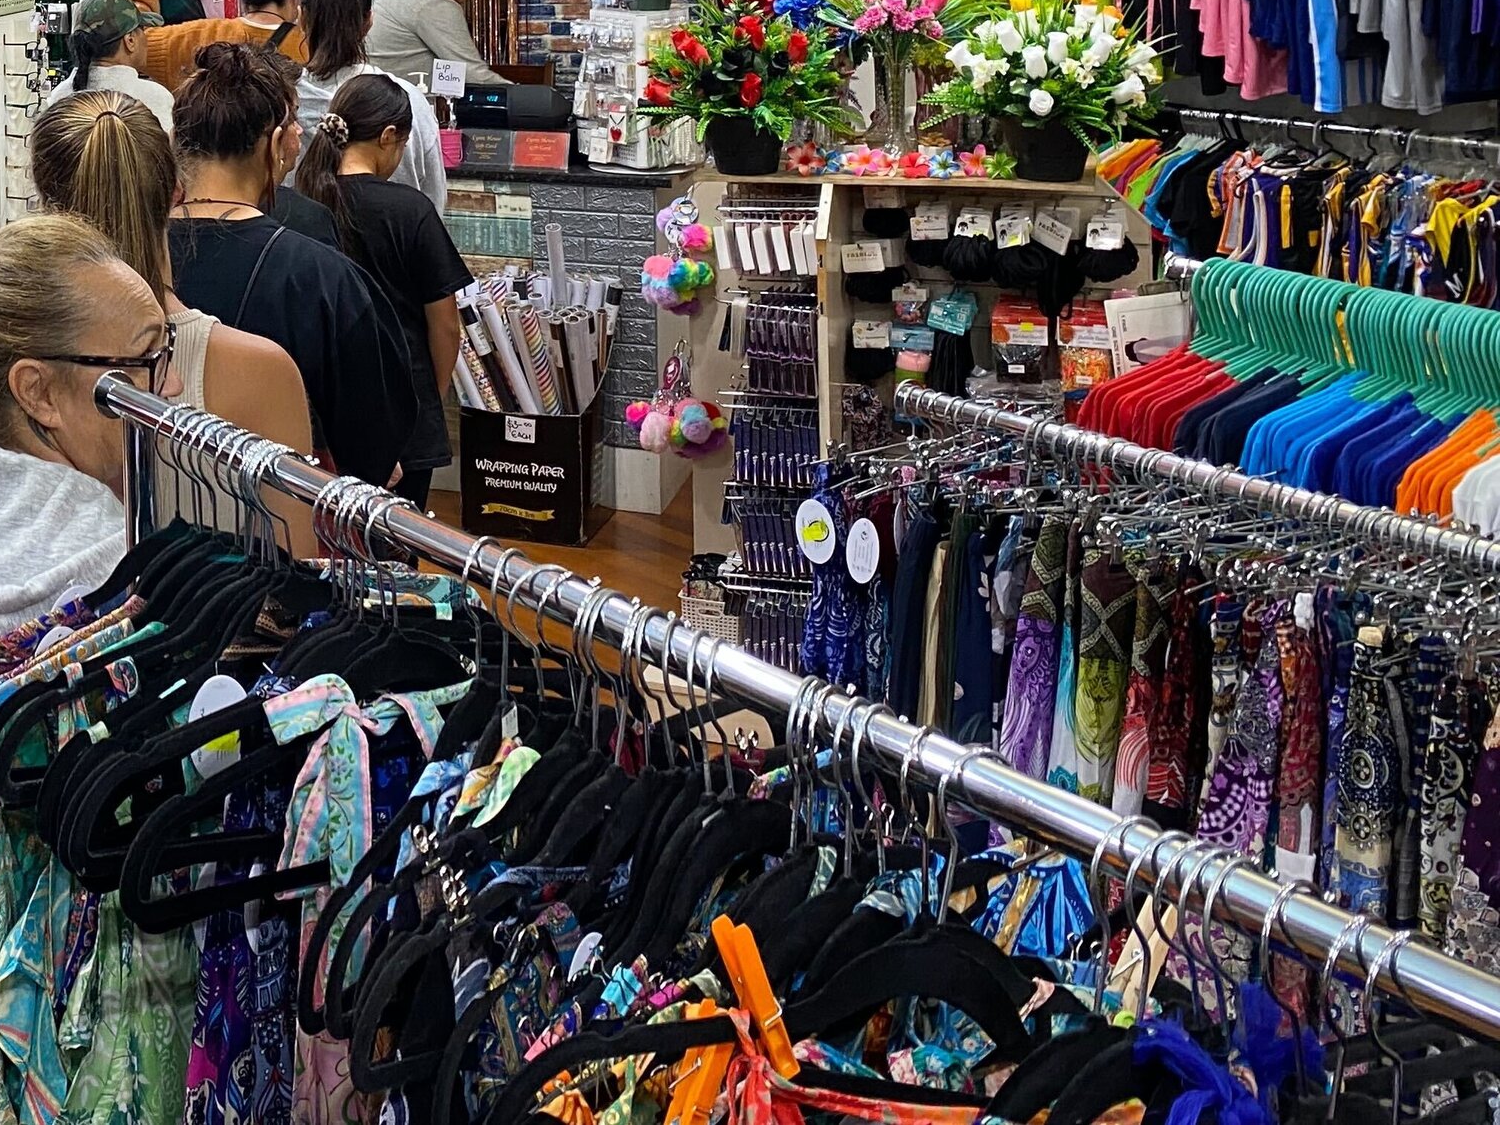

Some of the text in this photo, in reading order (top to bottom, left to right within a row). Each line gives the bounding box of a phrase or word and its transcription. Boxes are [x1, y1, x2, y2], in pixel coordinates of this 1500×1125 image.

[435, 62, 451, 73] Lip
[438, 73, 461, 83] Balm
[475, 458, 565, 480] WRAPPING PAPER
[484, 476, 557, 494] PREMIUM QUALITY
